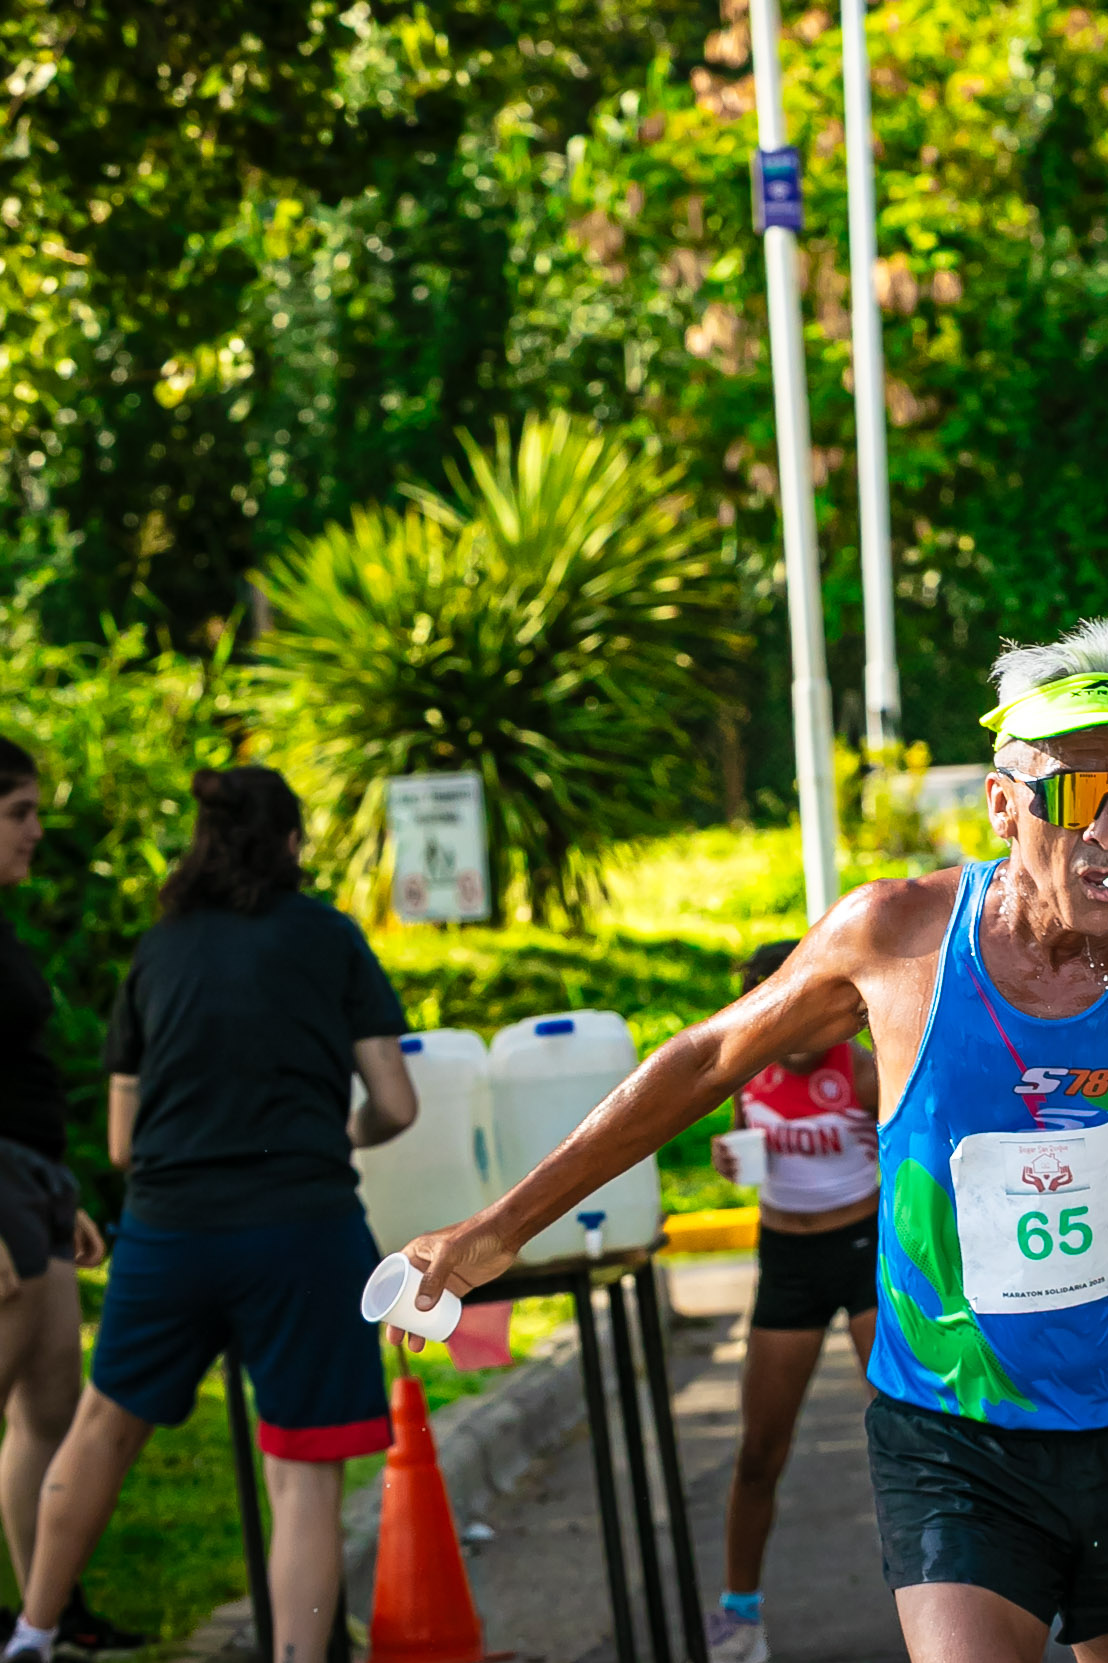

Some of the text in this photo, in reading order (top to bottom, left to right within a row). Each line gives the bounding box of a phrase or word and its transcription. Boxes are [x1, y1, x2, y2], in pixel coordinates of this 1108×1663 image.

[752, 1121, 842, 1156] NION
[1017, 1205, 1093, 1261] 65
[1002, 1289, 1043, 1298] MARATON
[1045, 1282, 1087, 1296] SOLIDARIA
